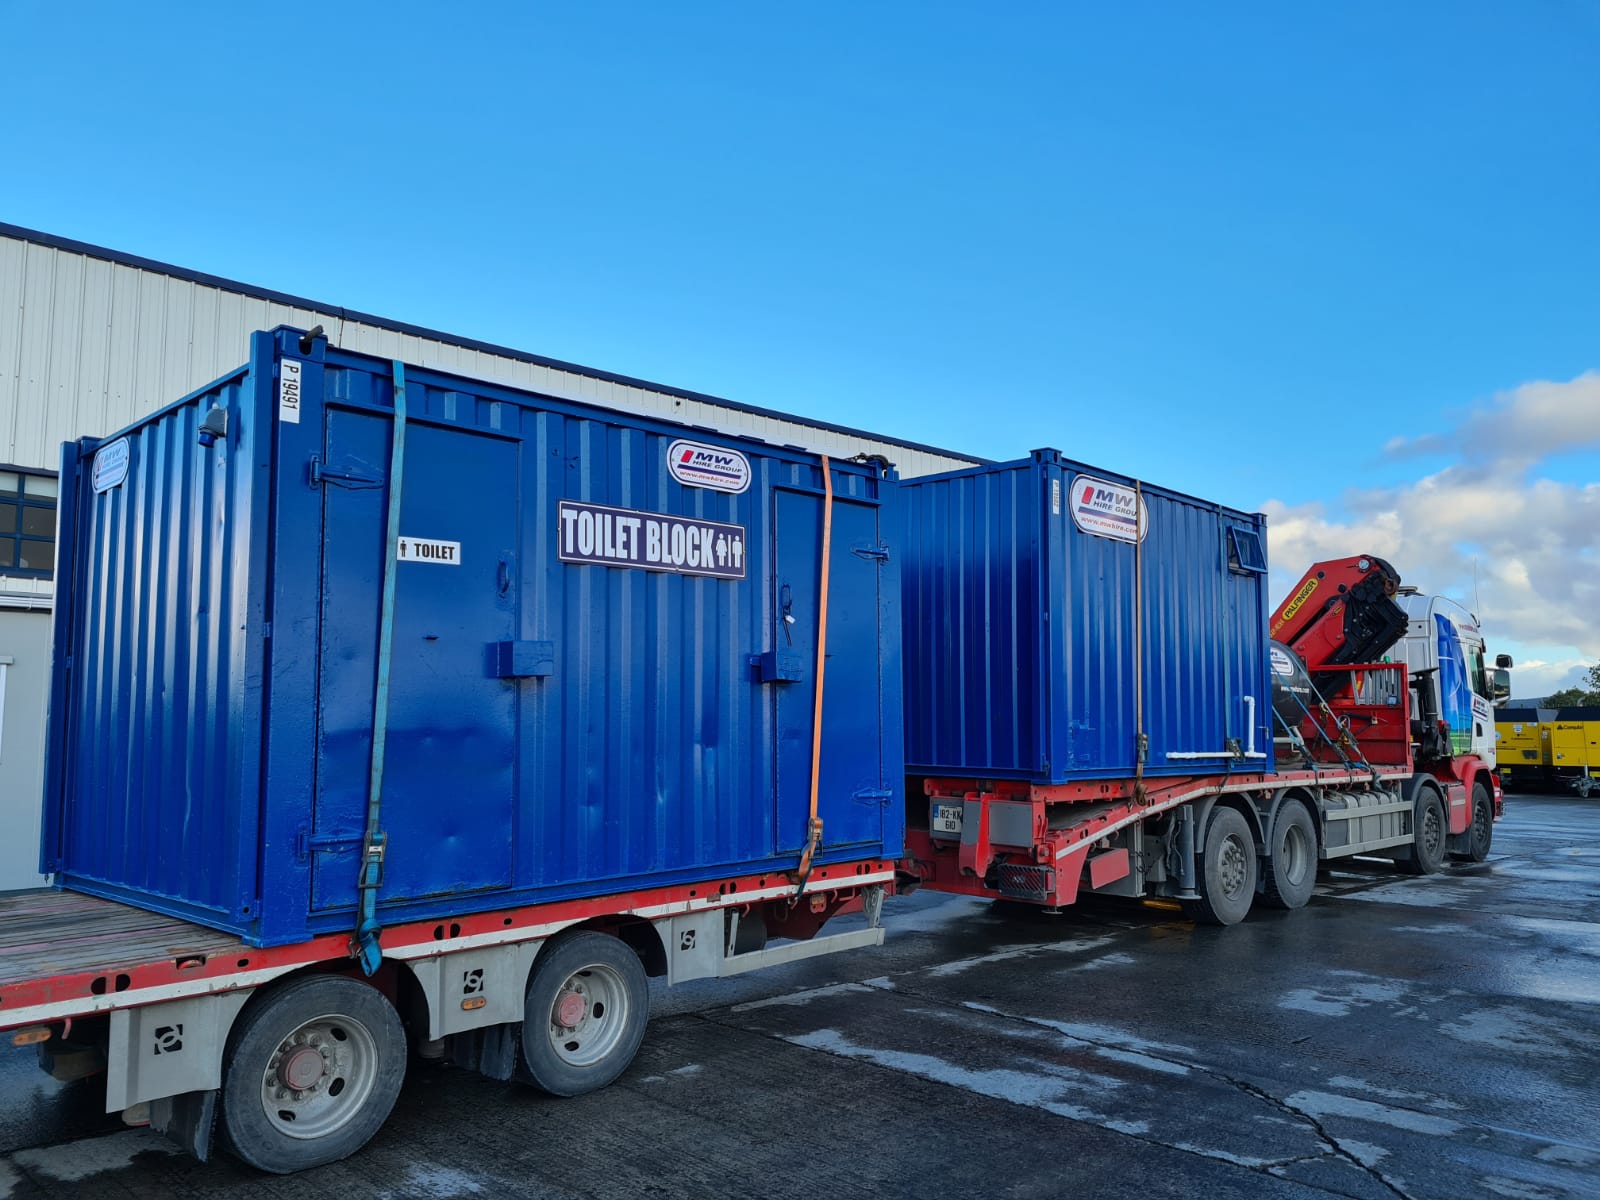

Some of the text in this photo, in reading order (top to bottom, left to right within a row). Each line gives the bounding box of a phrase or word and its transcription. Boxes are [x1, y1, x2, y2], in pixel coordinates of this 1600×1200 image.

[282, 364, 299, 410] P 19491
[696, 452, 734, 466] MW
[714, 465, 743, 473] GROUP
[1096, 489, 1134, 507] MW
[1093, 501, 1137, 517] HIRE GROU
[562, 508, 715, 569] TOILET BLOCK
[414, 543, 455, 560] TOILET
[1284, 580, 1317, 618] PALFINGER
[945, 820, 956, 830] 610
